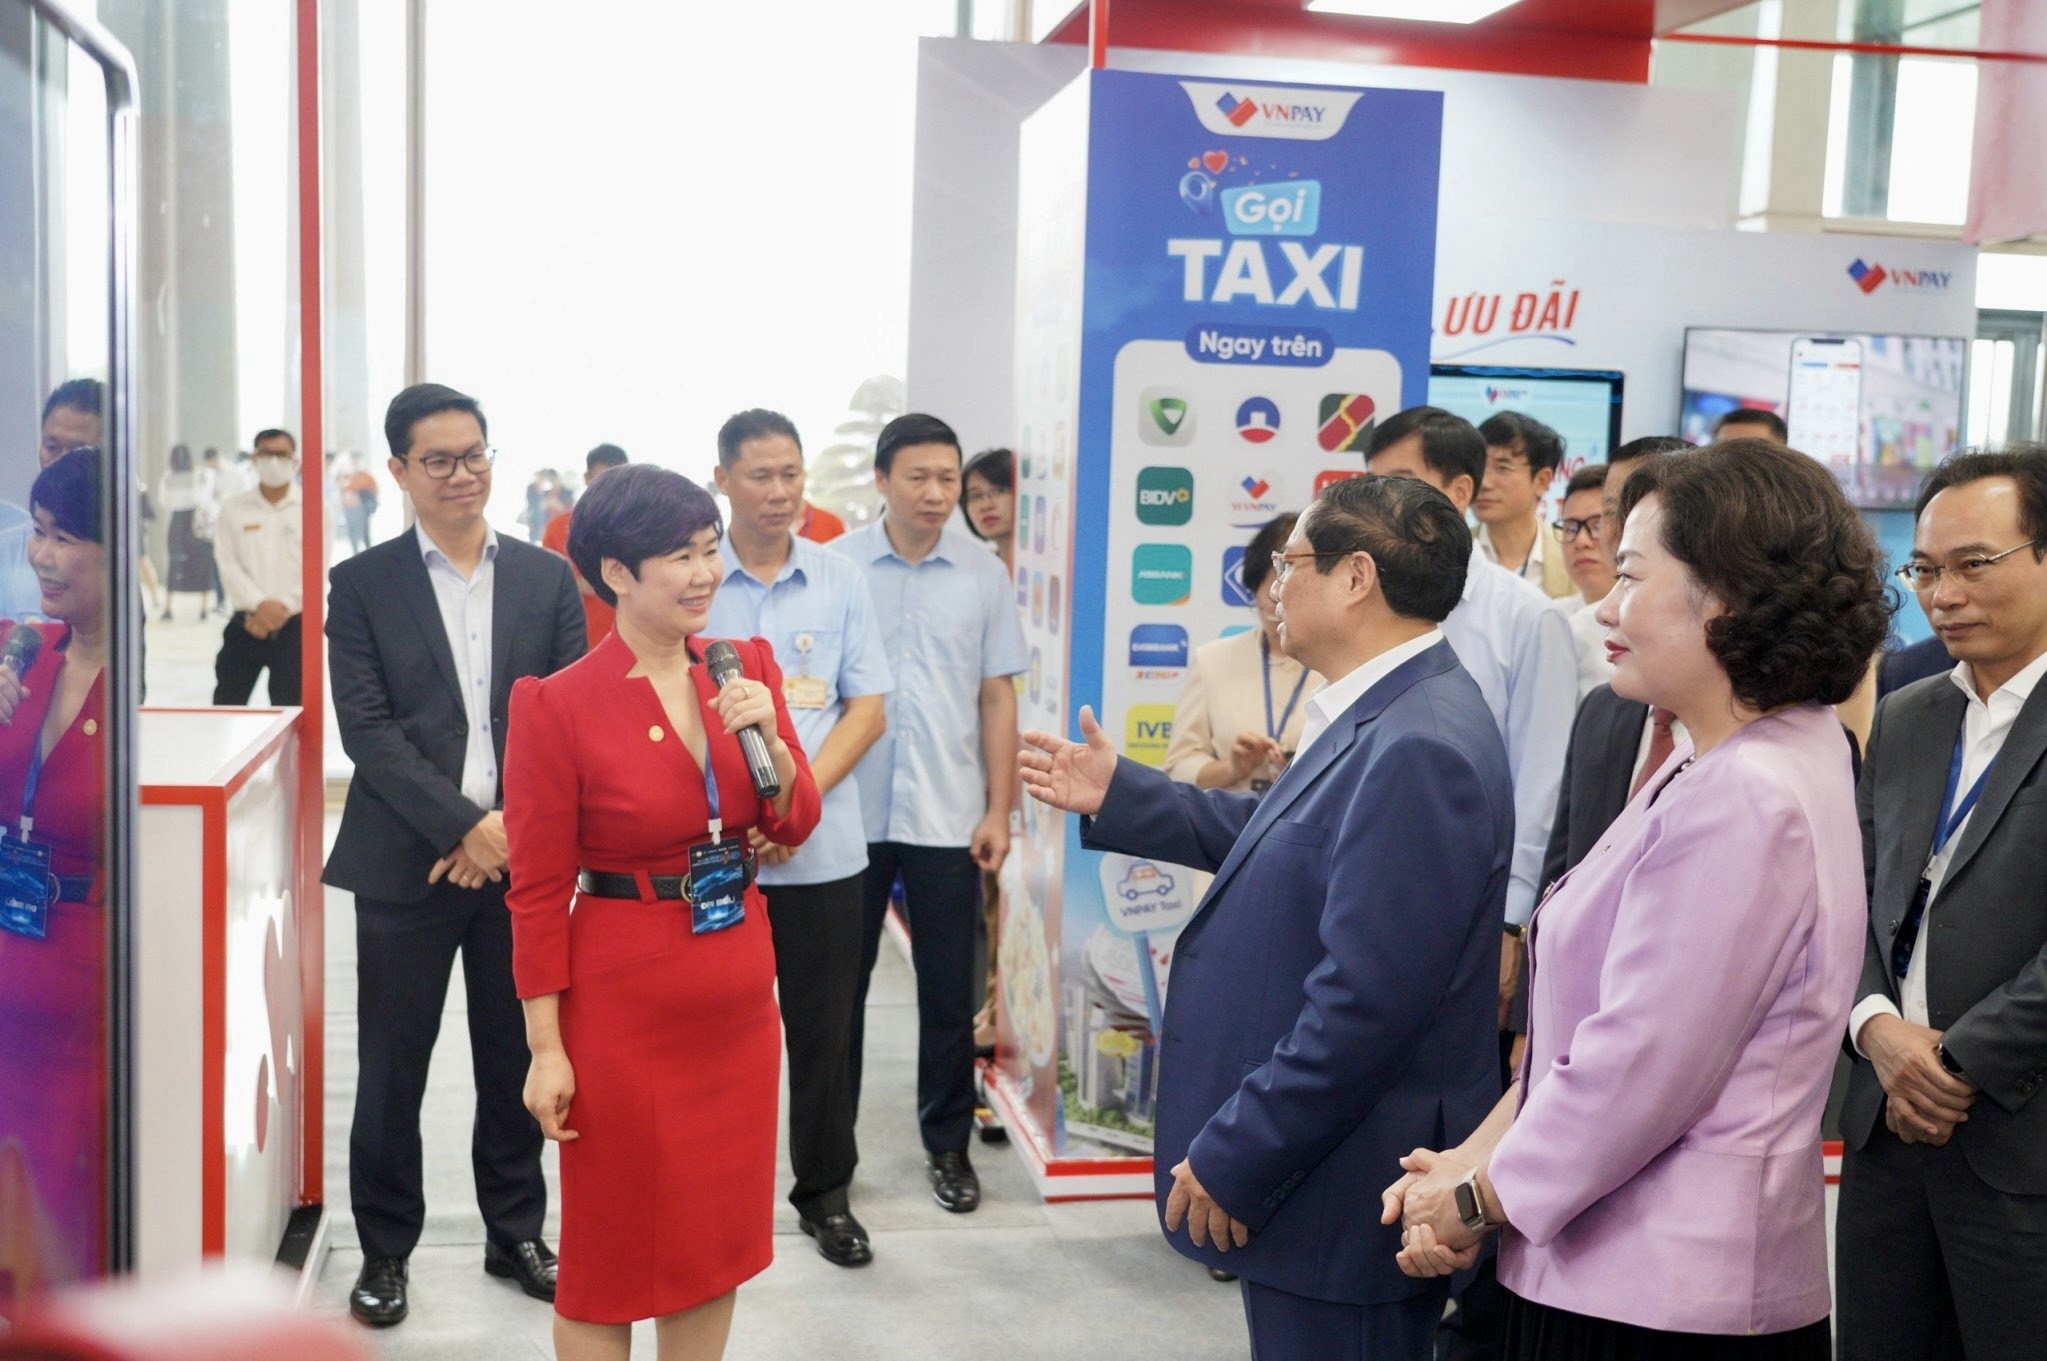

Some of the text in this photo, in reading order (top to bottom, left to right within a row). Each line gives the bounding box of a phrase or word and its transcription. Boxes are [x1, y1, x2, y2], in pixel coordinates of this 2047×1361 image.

[1261, 103, 1326, 122] VNPAY
[1234, 188, 1306, 233] Gọi
[1167, 239, 1364, 310] TAXI
[1890, 270, 1951, 288] VNPAY
[1443, 279, 1580, 335] ƯU ĐÃI
[1199, 331, 1323, 360] Ngay trên
[1140, 489, 1177, 506] BIDV
